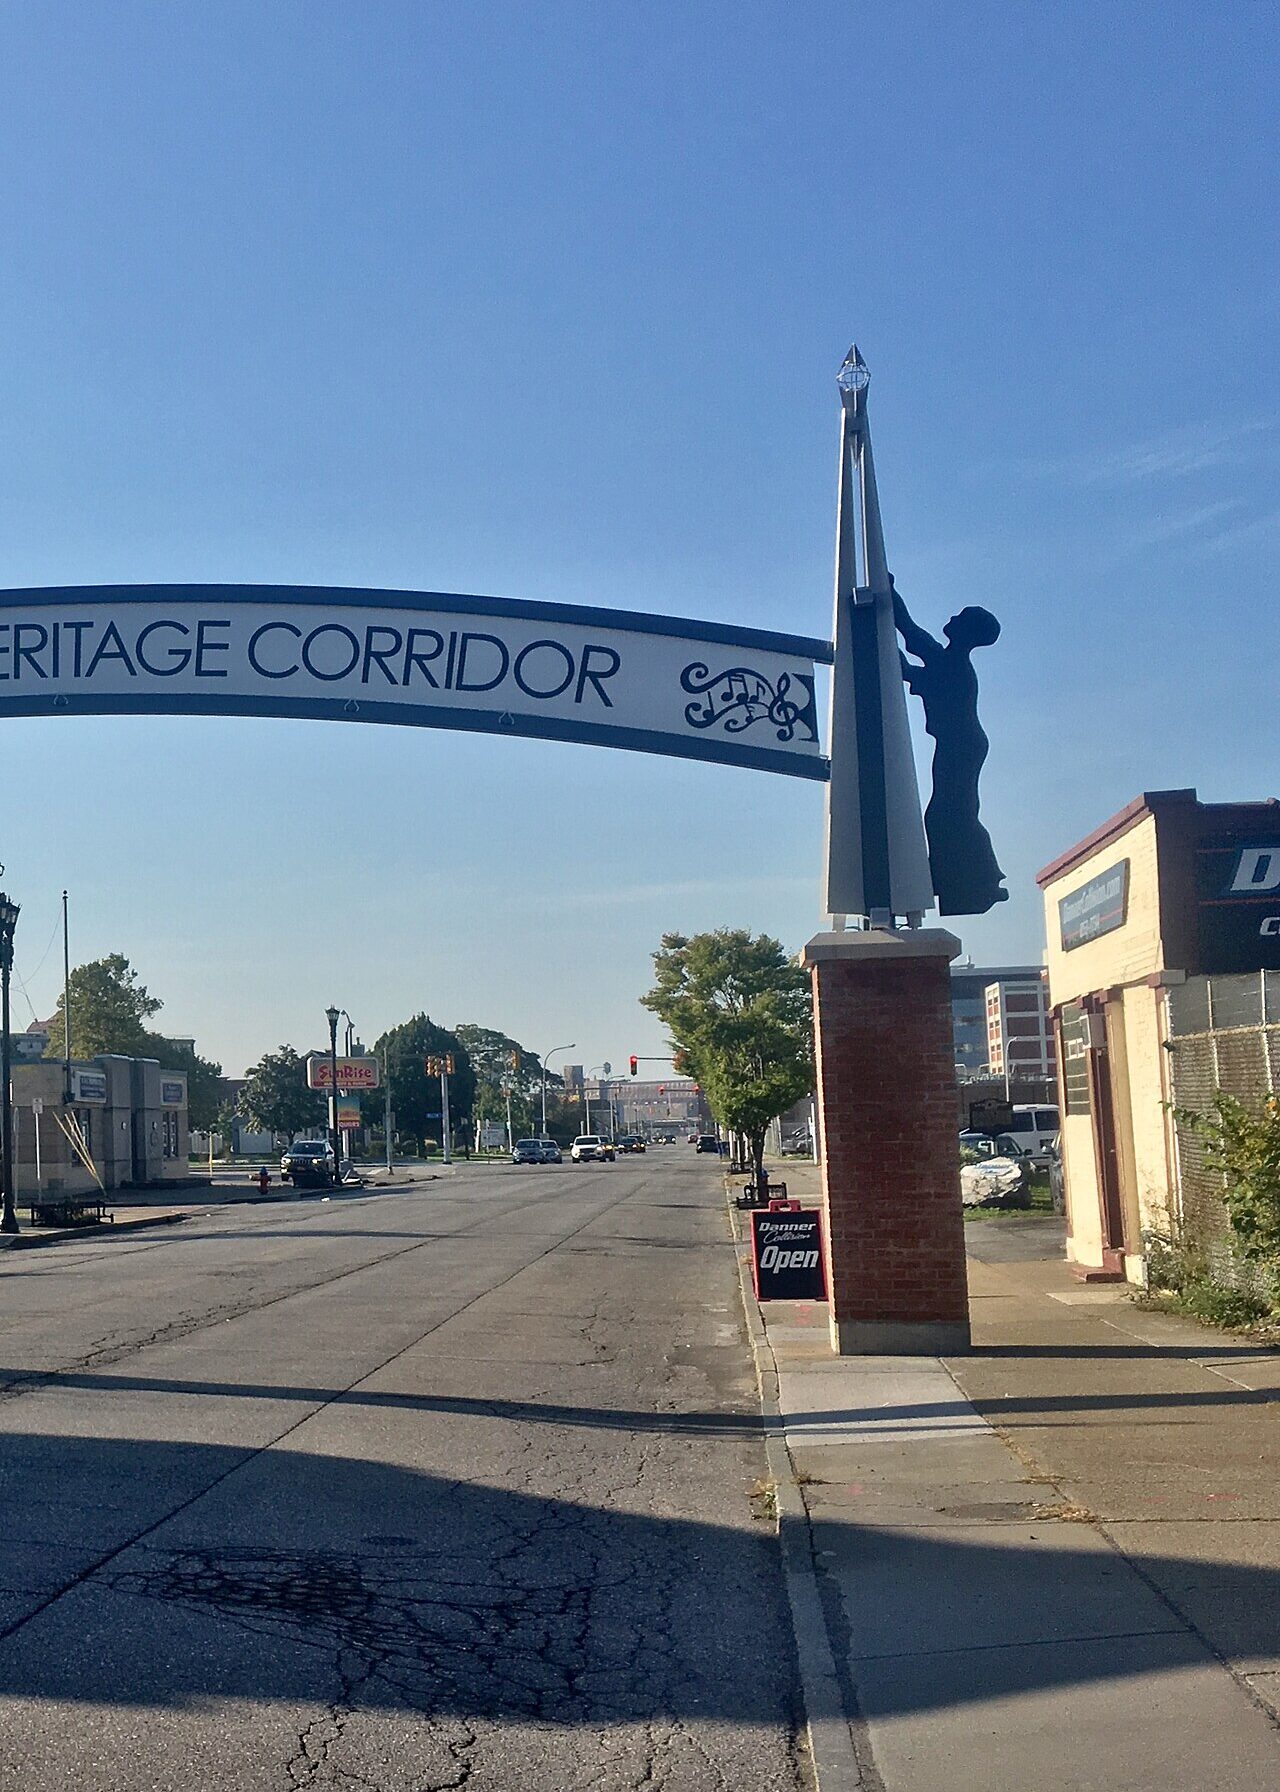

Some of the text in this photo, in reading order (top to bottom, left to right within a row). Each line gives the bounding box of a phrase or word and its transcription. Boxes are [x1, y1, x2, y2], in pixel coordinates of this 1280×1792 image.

[246, 620, 622, 707] CORRIDOR
[758, 1222, 817, 1232] Danner
[763, 1230, 811, 1244] Collision
[760, 1245, 819, 1274] Open
